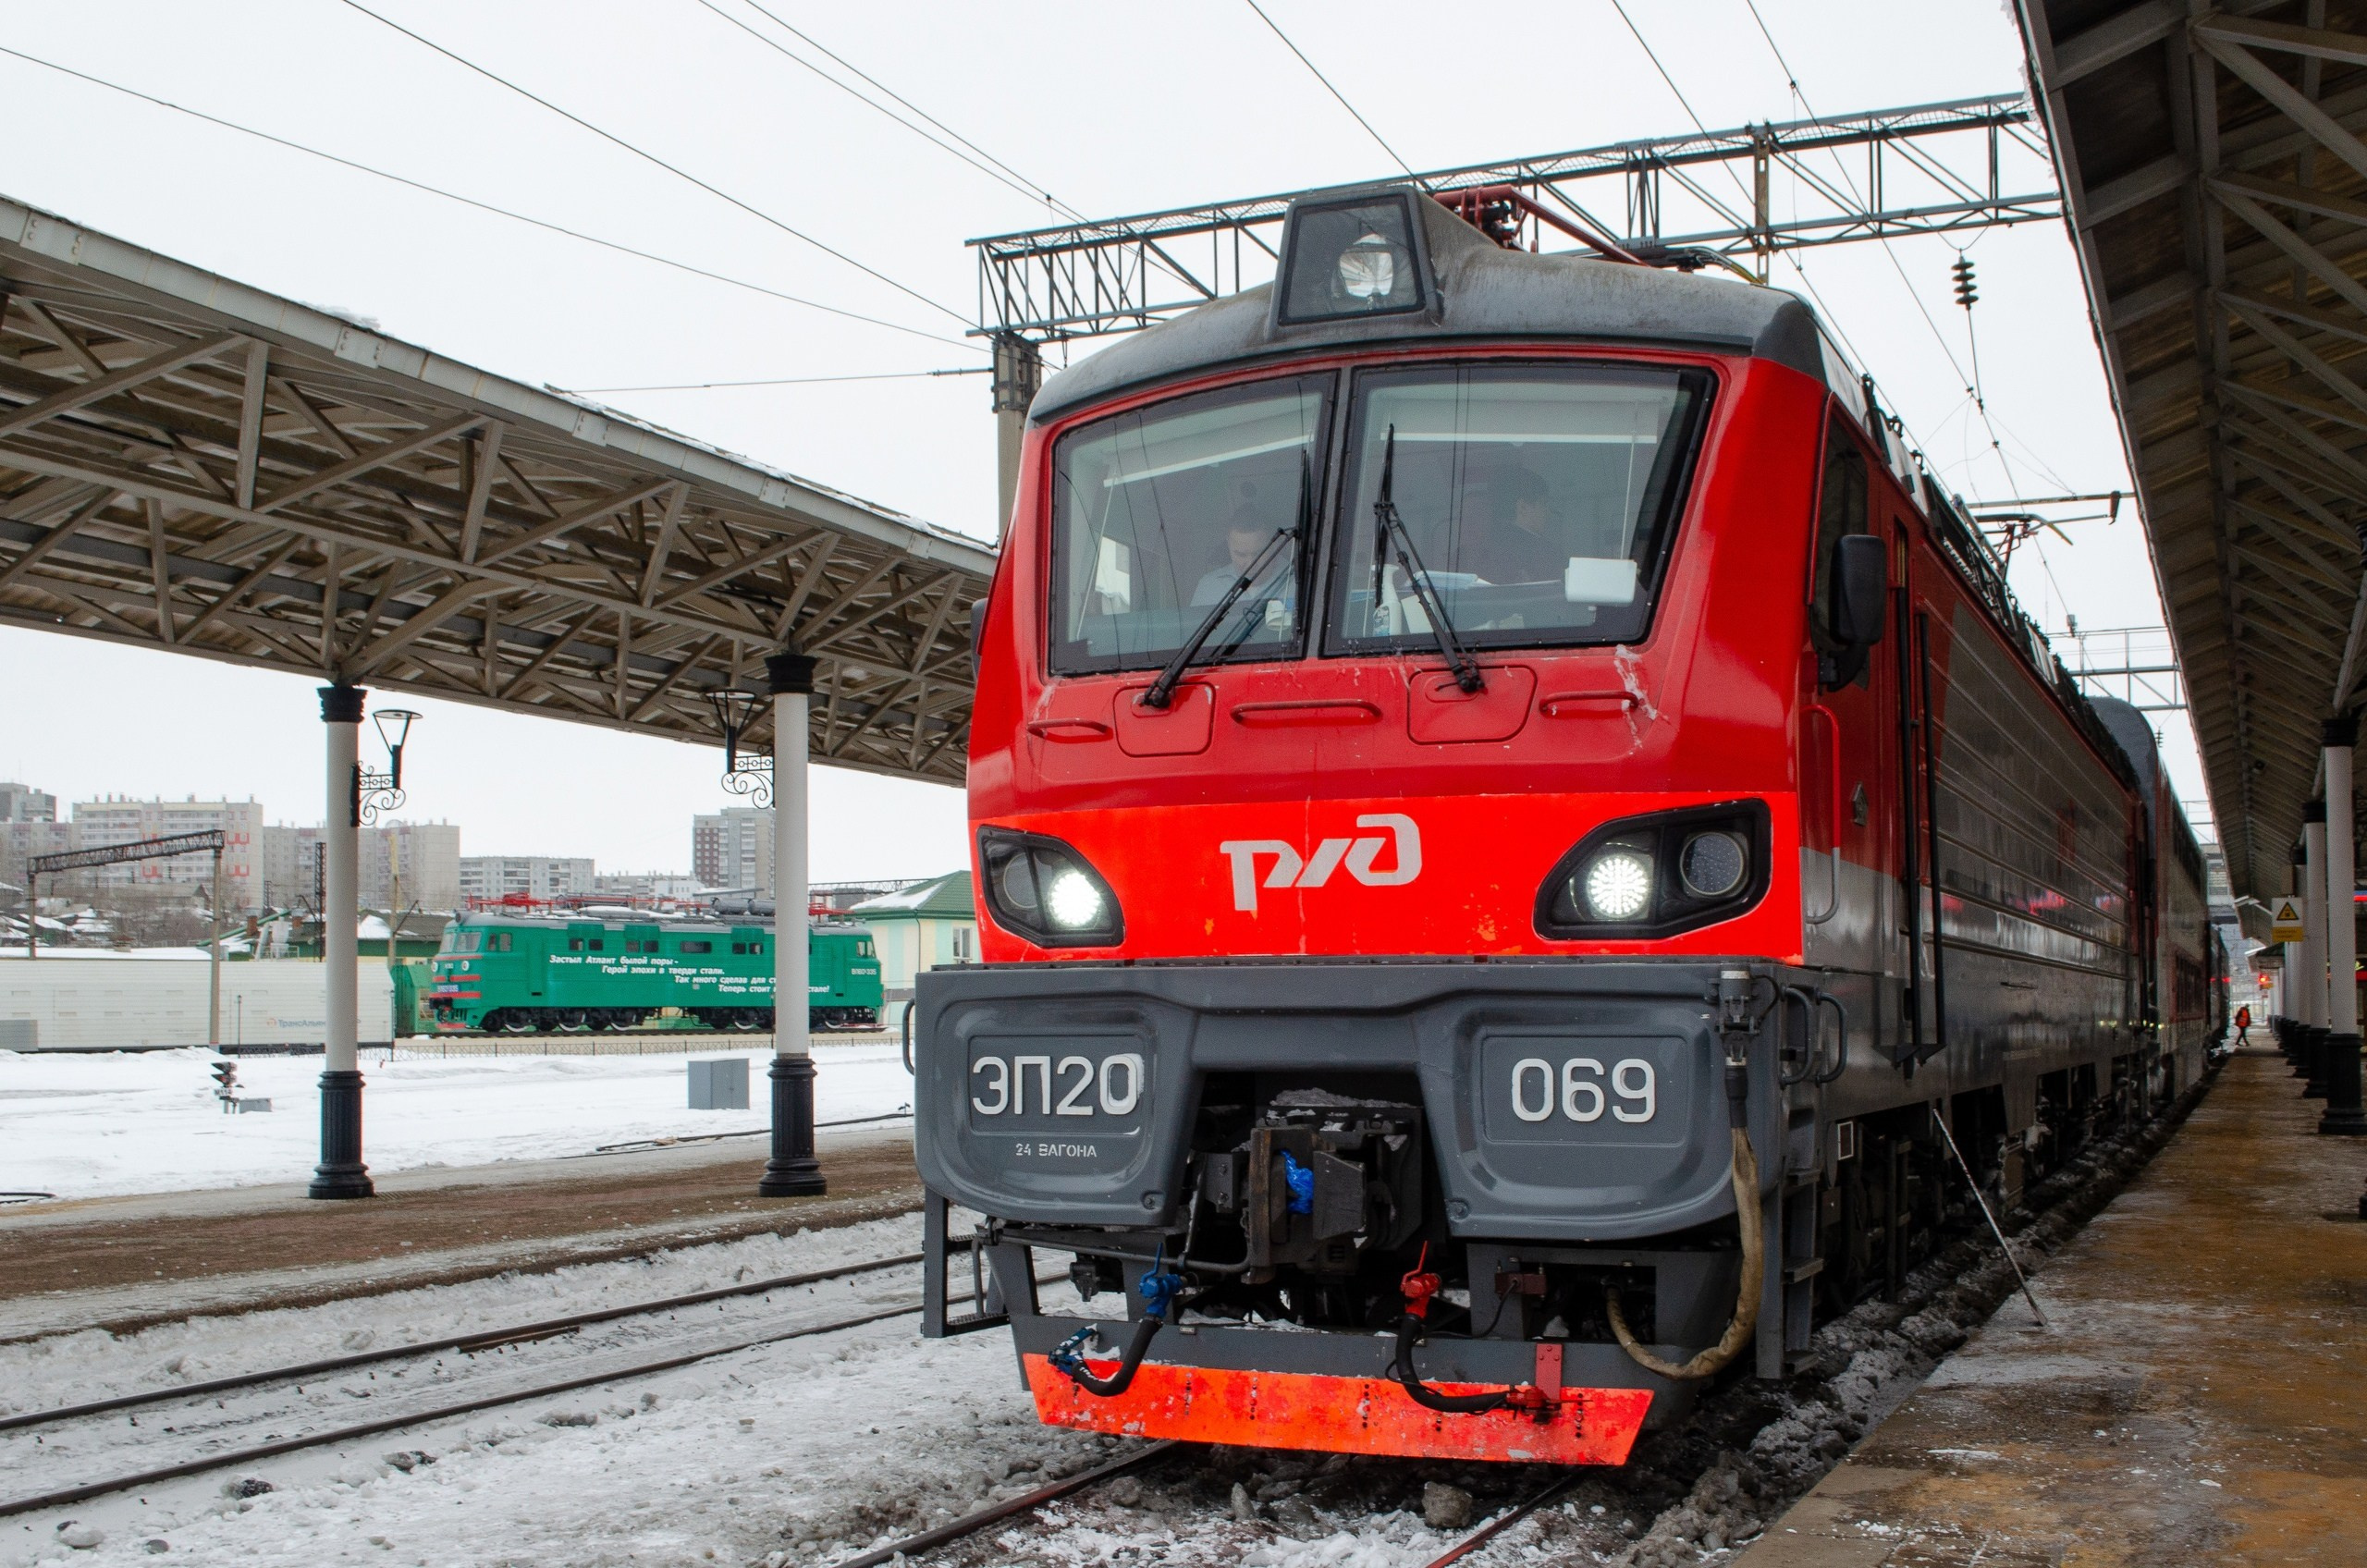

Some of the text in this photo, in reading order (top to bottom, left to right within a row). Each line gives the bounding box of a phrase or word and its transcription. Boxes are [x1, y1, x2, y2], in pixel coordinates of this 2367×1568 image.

[549, 954, 583, 964] Застыл
[585, 955, 616, 964] Атлант
[619, 955, 648, 965] былой
[602, 964, 628, 975] Герой
[668, 967, 696, 976] тверди
[700, 967, 725, 975] стали.
[675, 974, 689, 984] Так
[719, 976, 748, 985] сделав
[751, 976, 766, 985] для
[718, 984, 746, 994] Теперь
[973, 1054, 1139, 1116] ЭП20
[1512, 1058, 1655, 1123] 069
[1015, 1143, 1098, 1158] 24 ВАГОНА
